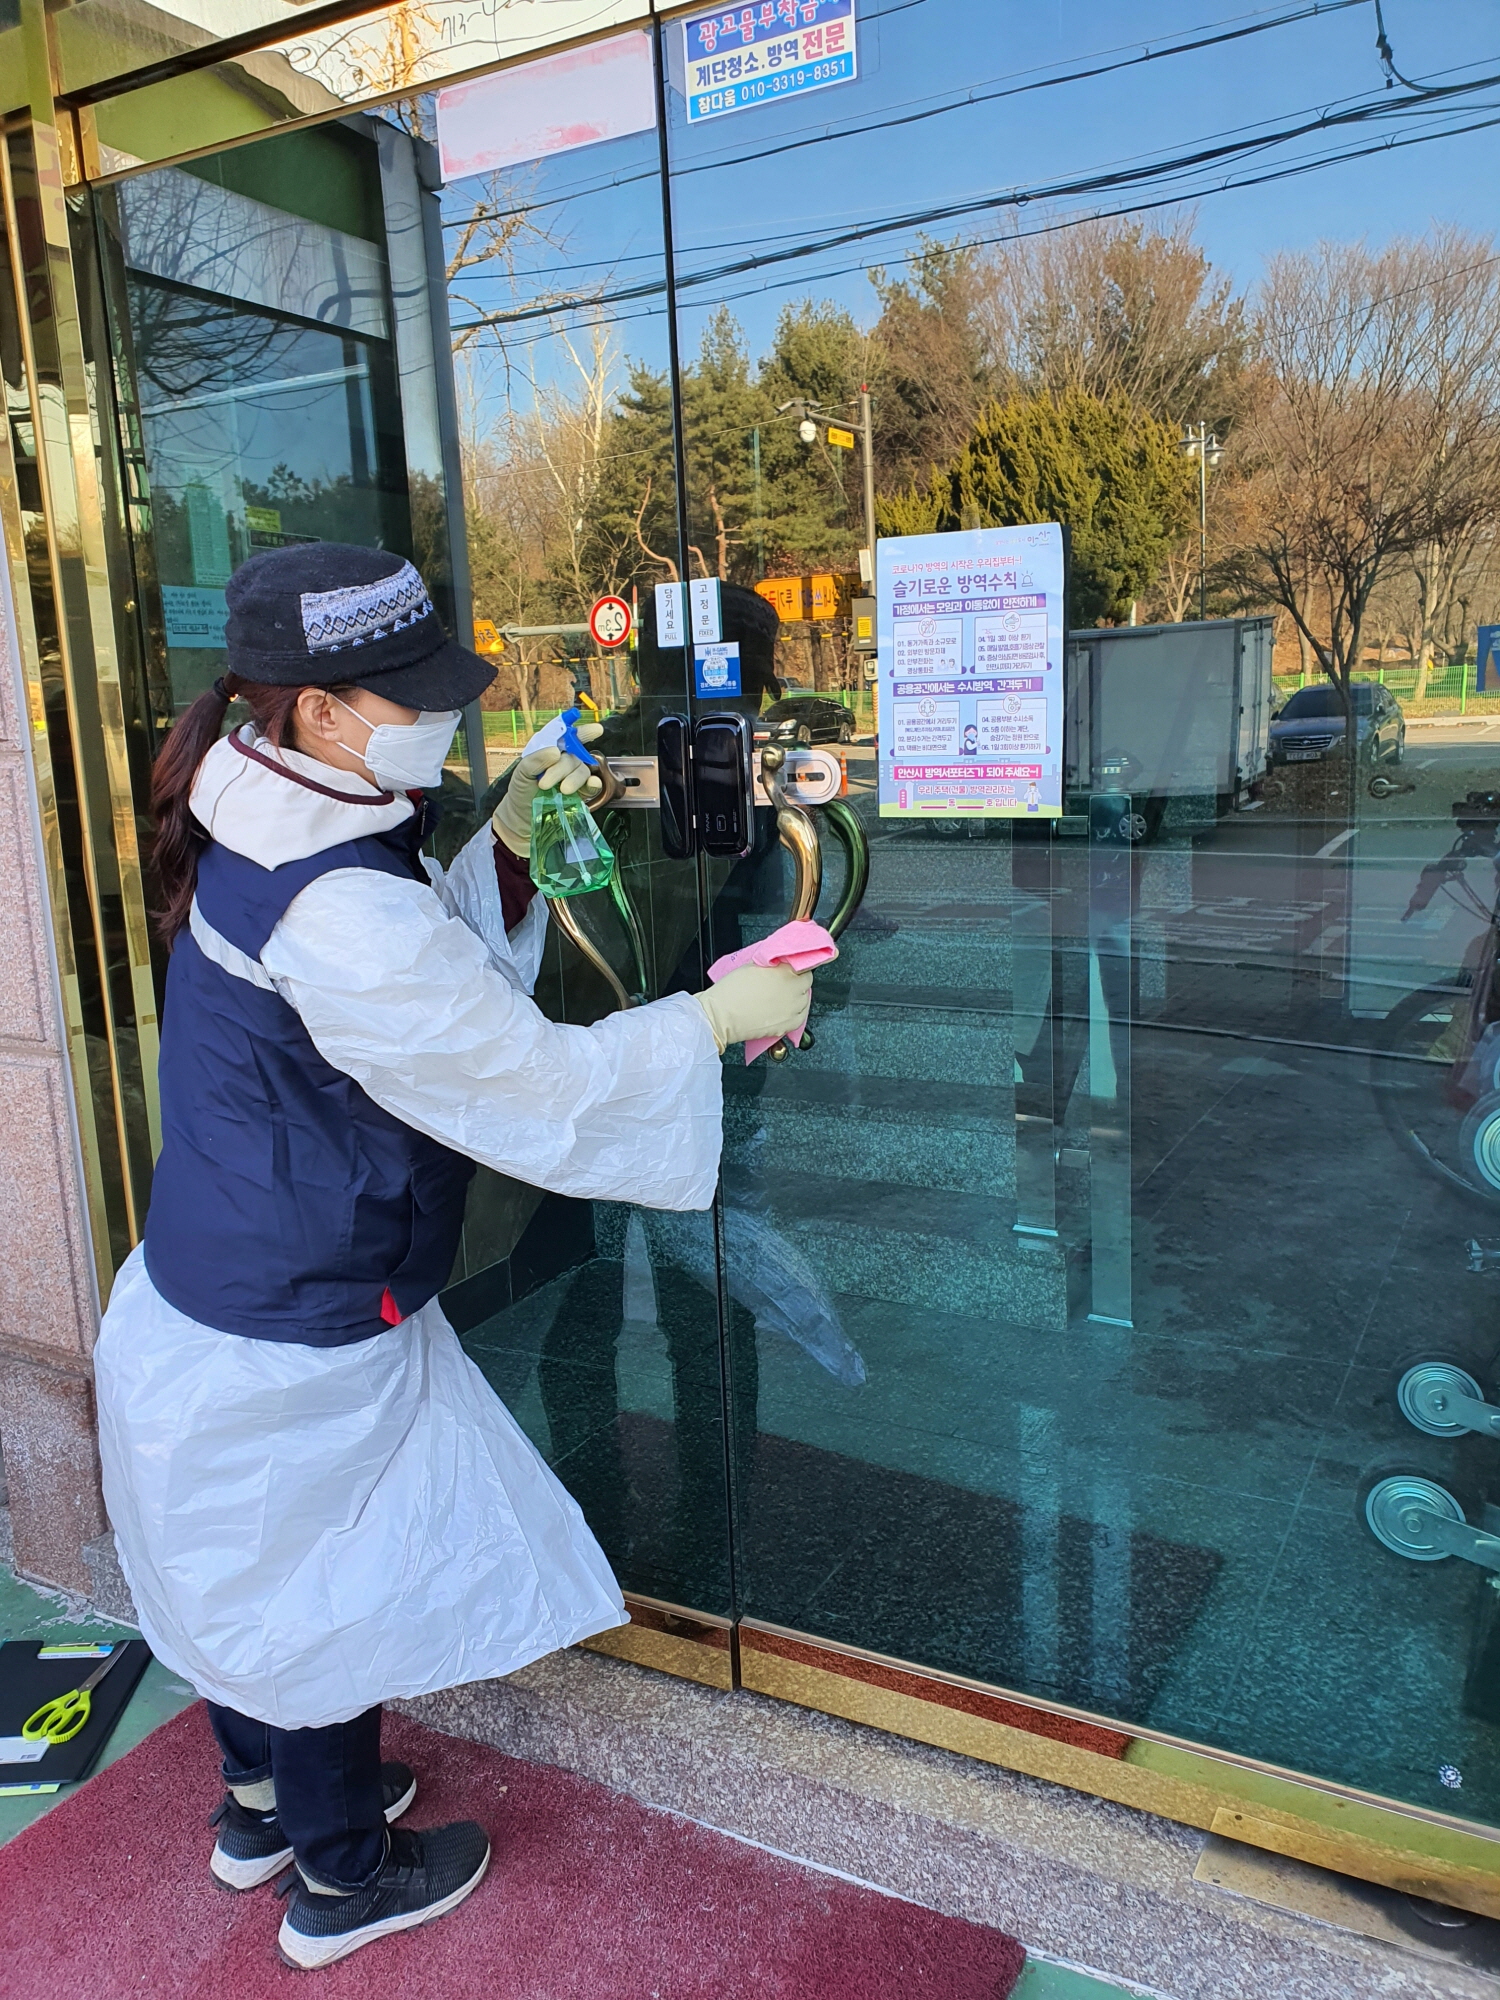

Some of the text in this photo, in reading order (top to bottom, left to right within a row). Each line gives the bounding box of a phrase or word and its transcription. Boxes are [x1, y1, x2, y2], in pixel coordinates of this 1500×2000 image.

[802, 22, 845, 60] 전문
[698, 59, 845, 114] 참다움 010-3319-8351
[892, 556, 1022, 574] 코로나19 방역의 시작은 우리집부터~!
[893, 572, 1017, 598] 슬기로운 방역수칙
[664, 588, 674, 629] 당기세요
[699, 584, 709, 625] 고정문
[894, 596, 1037, 615] 가정에서는 모임과 이동없이 안전하게
[897, 679, 1031, 694] 공용공간에서는 수시방역, 간격두기
[898, 766, 1038, 778] 안산시 방역서포터즈가 되어 주세요~!
[918, 785, 1015, 795] 우리 주택(건물) 방역관리자는
[948, 798, 1017, 807] 동 호 입니다
